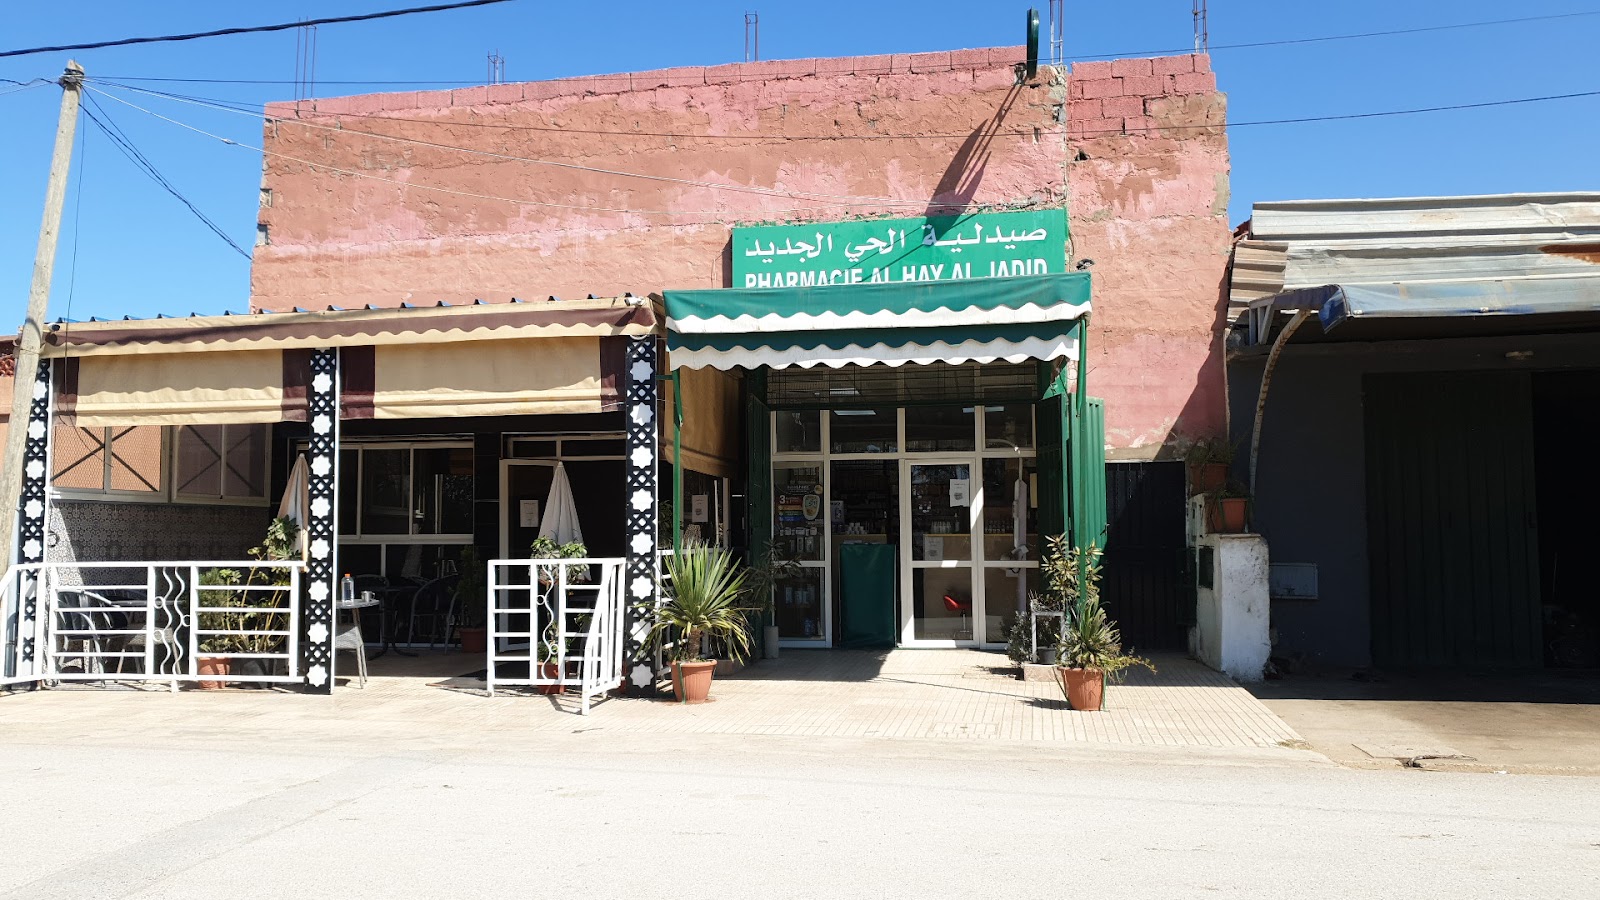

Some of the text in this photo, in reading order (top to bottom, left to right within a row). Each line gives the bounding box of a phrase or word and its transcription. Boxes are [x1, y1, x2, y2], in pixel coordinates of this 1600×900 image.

[745, 222, 1047, 263] صيدلية الحي الجديد
[745, 268, 863, 288] PHARMACIE
[902, 263, 945, 282] HAY
[985, 258, 1048, 278] JADID
